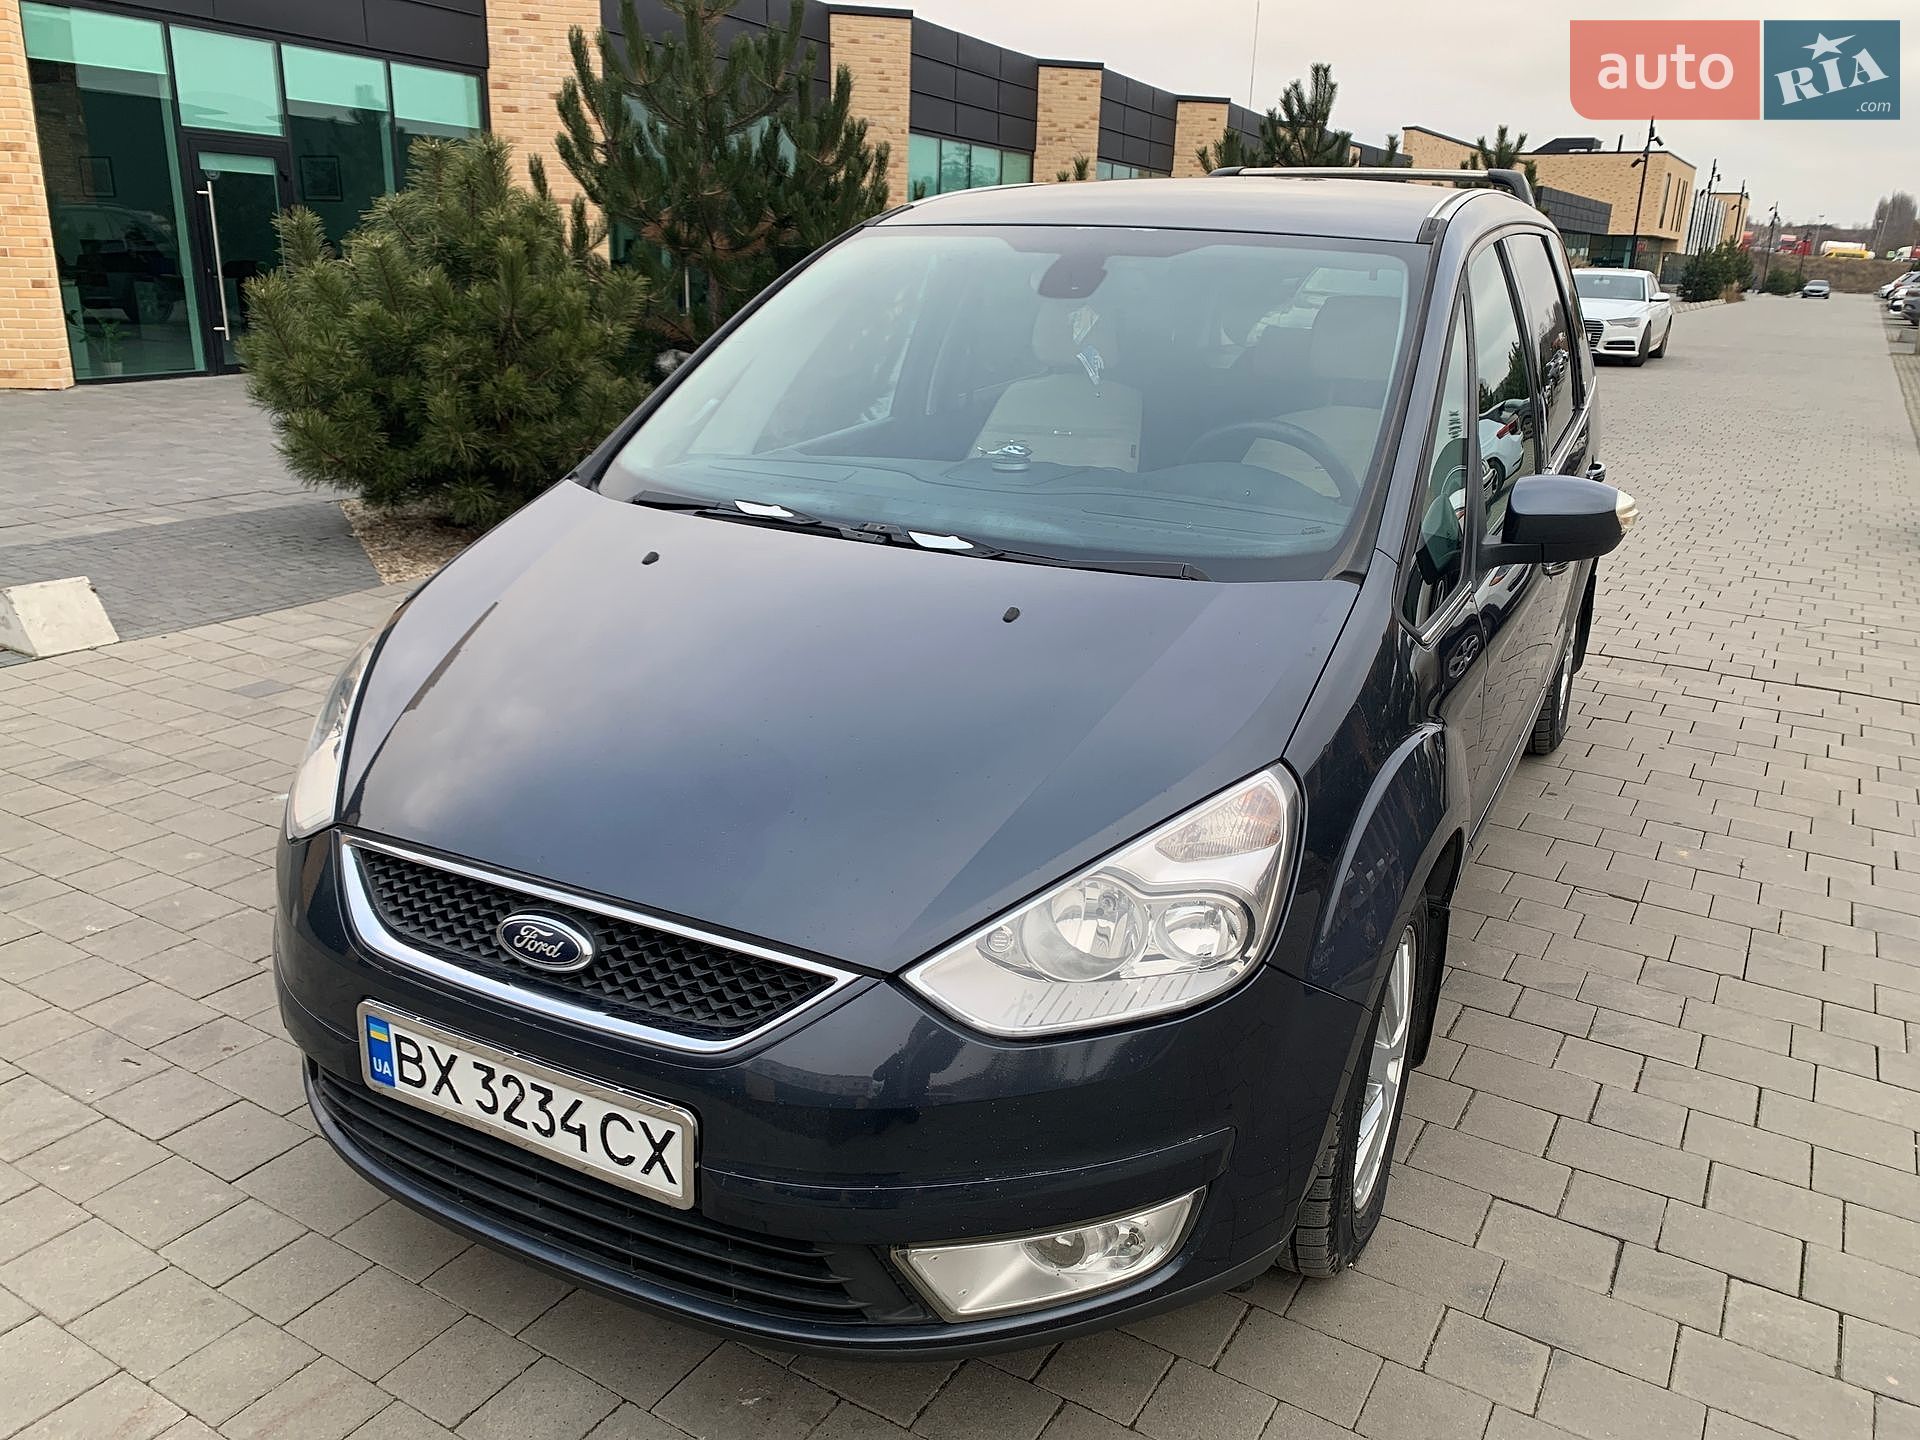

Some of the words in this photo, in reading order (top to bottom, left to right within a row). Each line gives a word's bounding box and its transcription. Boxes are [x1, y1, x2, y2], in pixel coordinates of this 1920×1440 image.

[513, 925, 564, 958] Ford
[373, 1057, 393, 1077] UA
[394, 1034, 463, 1105] BX
[473, 1062, 588, 1153] 3234
[600, 1112, 677, 1185] CX
